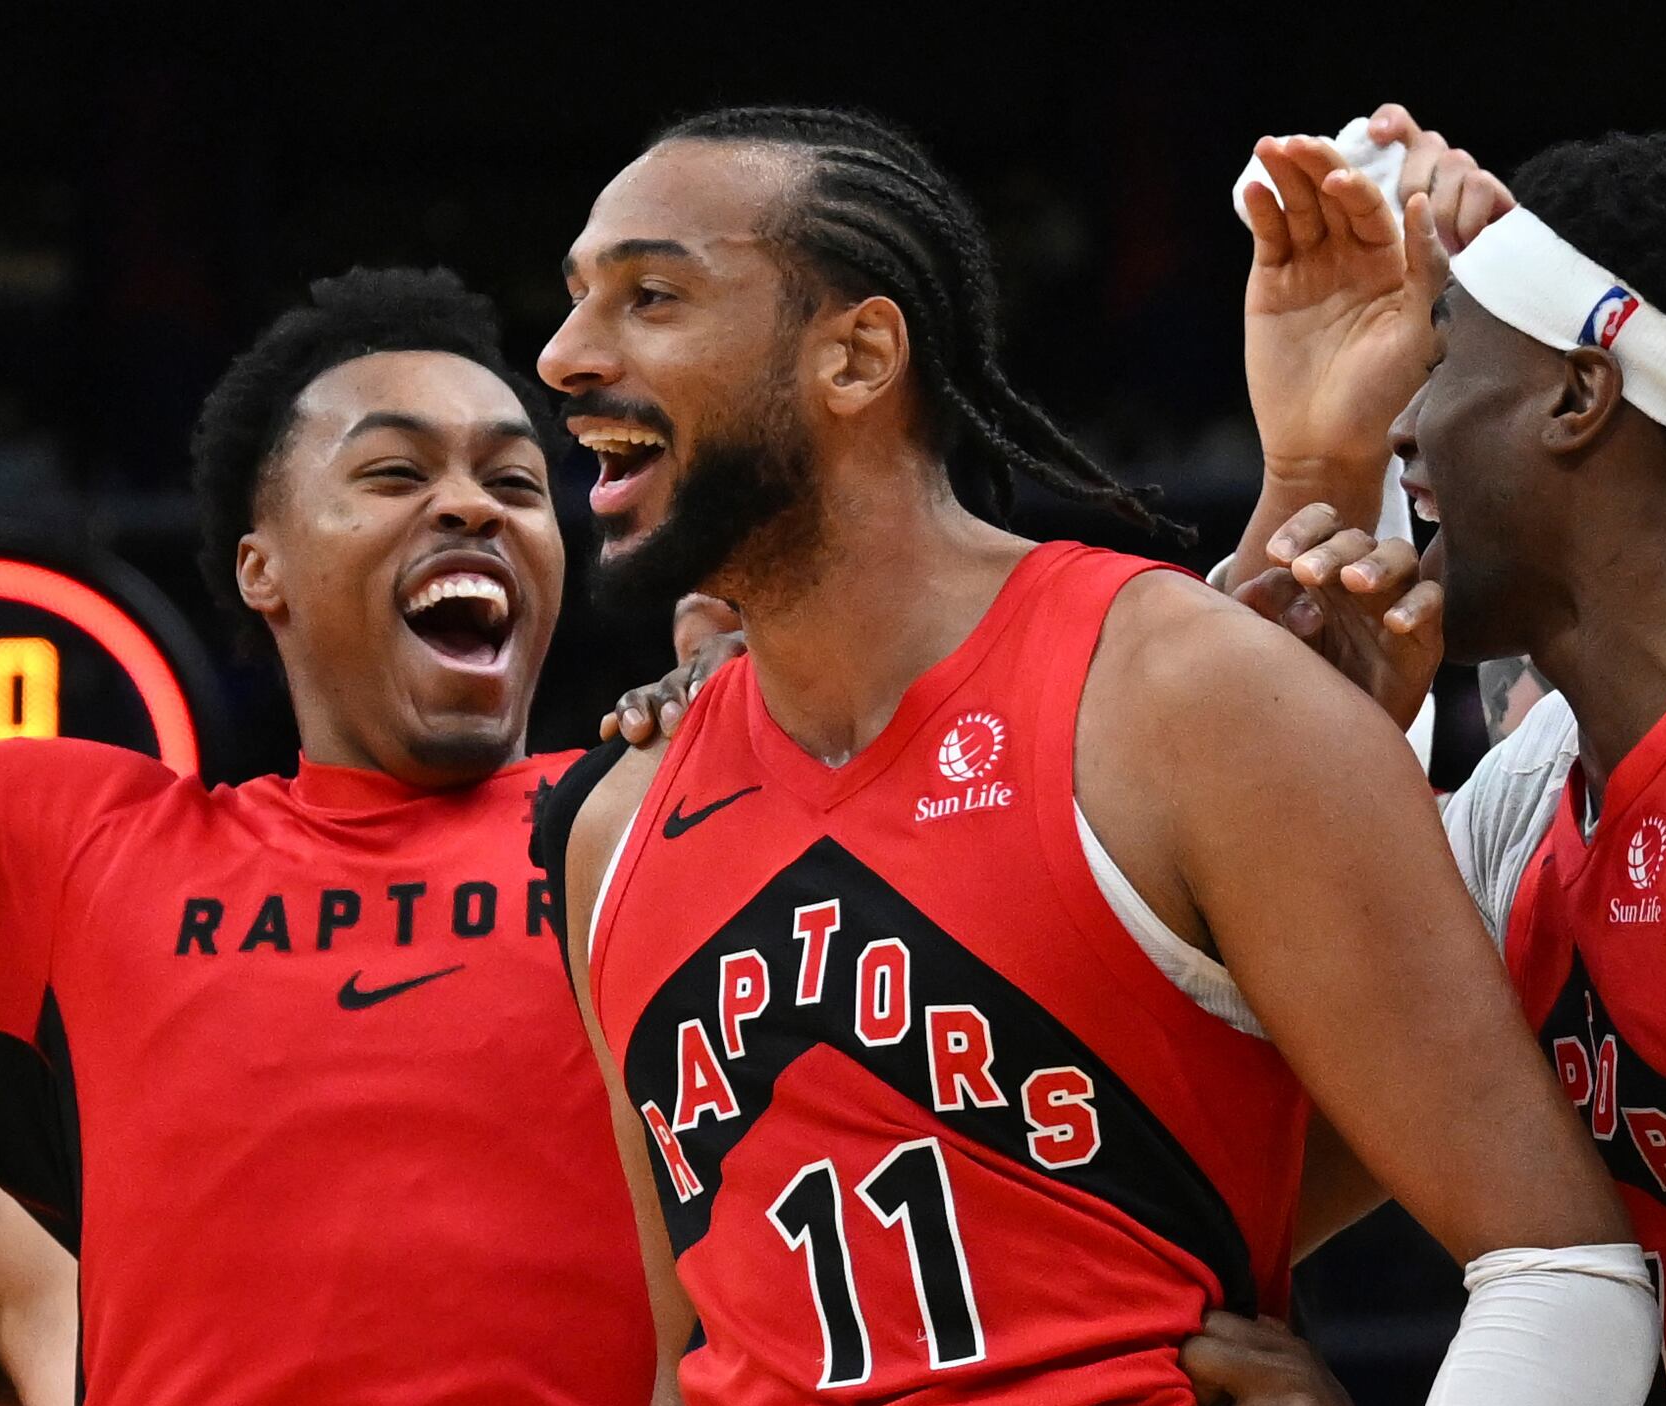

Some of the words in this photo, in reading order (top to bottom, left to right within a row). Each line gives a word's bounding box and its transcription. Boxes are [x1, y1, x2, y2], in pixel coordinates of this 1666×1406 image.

[915, 796, 960, 822] Sun
[964, 781, 1013, 811] Life
[175, 879, 556, 956] RAPTOR
[1609, 897, 1637, 923] Sun
[1638, 895, 1662, 923] Life
[640, 899, 1101, 1204] RAPTORS
[766, 1136, 986, 1391] 11
